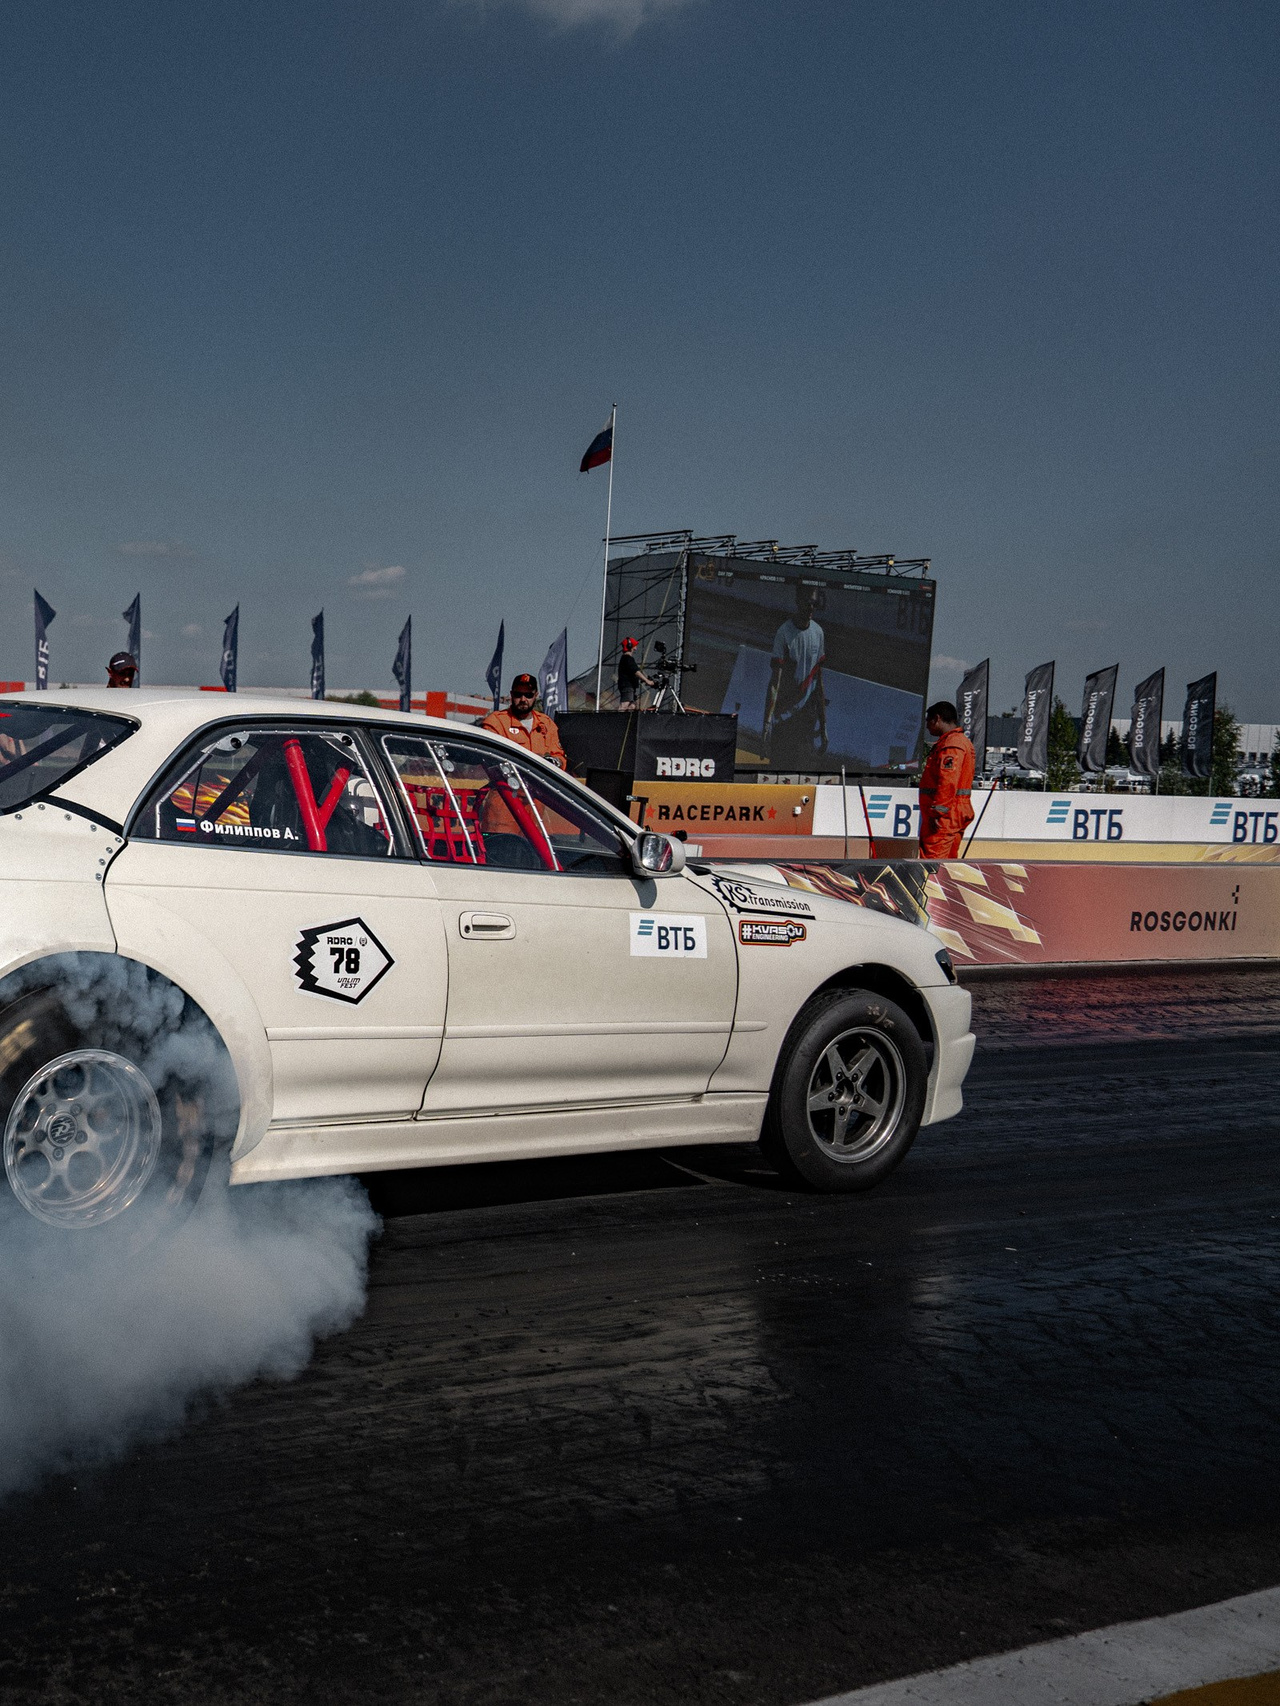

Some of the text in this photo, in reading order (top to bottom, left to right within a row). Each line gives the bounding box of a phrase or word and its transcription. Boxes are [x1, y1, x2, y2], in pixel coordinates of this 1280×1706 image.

[656, 757, 715, 777] RDRC
[658, 805, 765, 821] RACEPARK
[200, 820, 299, 840] Филиппов А.
[1072, 809, 1123, 840] ВТБ
[1232, 811, 1279, 843] ВТБ
[1130, 911, 1237, 932] ROSGONKI
[327, 937, 353, 945] RDRC
[657, 926, 696, 951] ВТБ
[330, 947, 360, 974] 78
